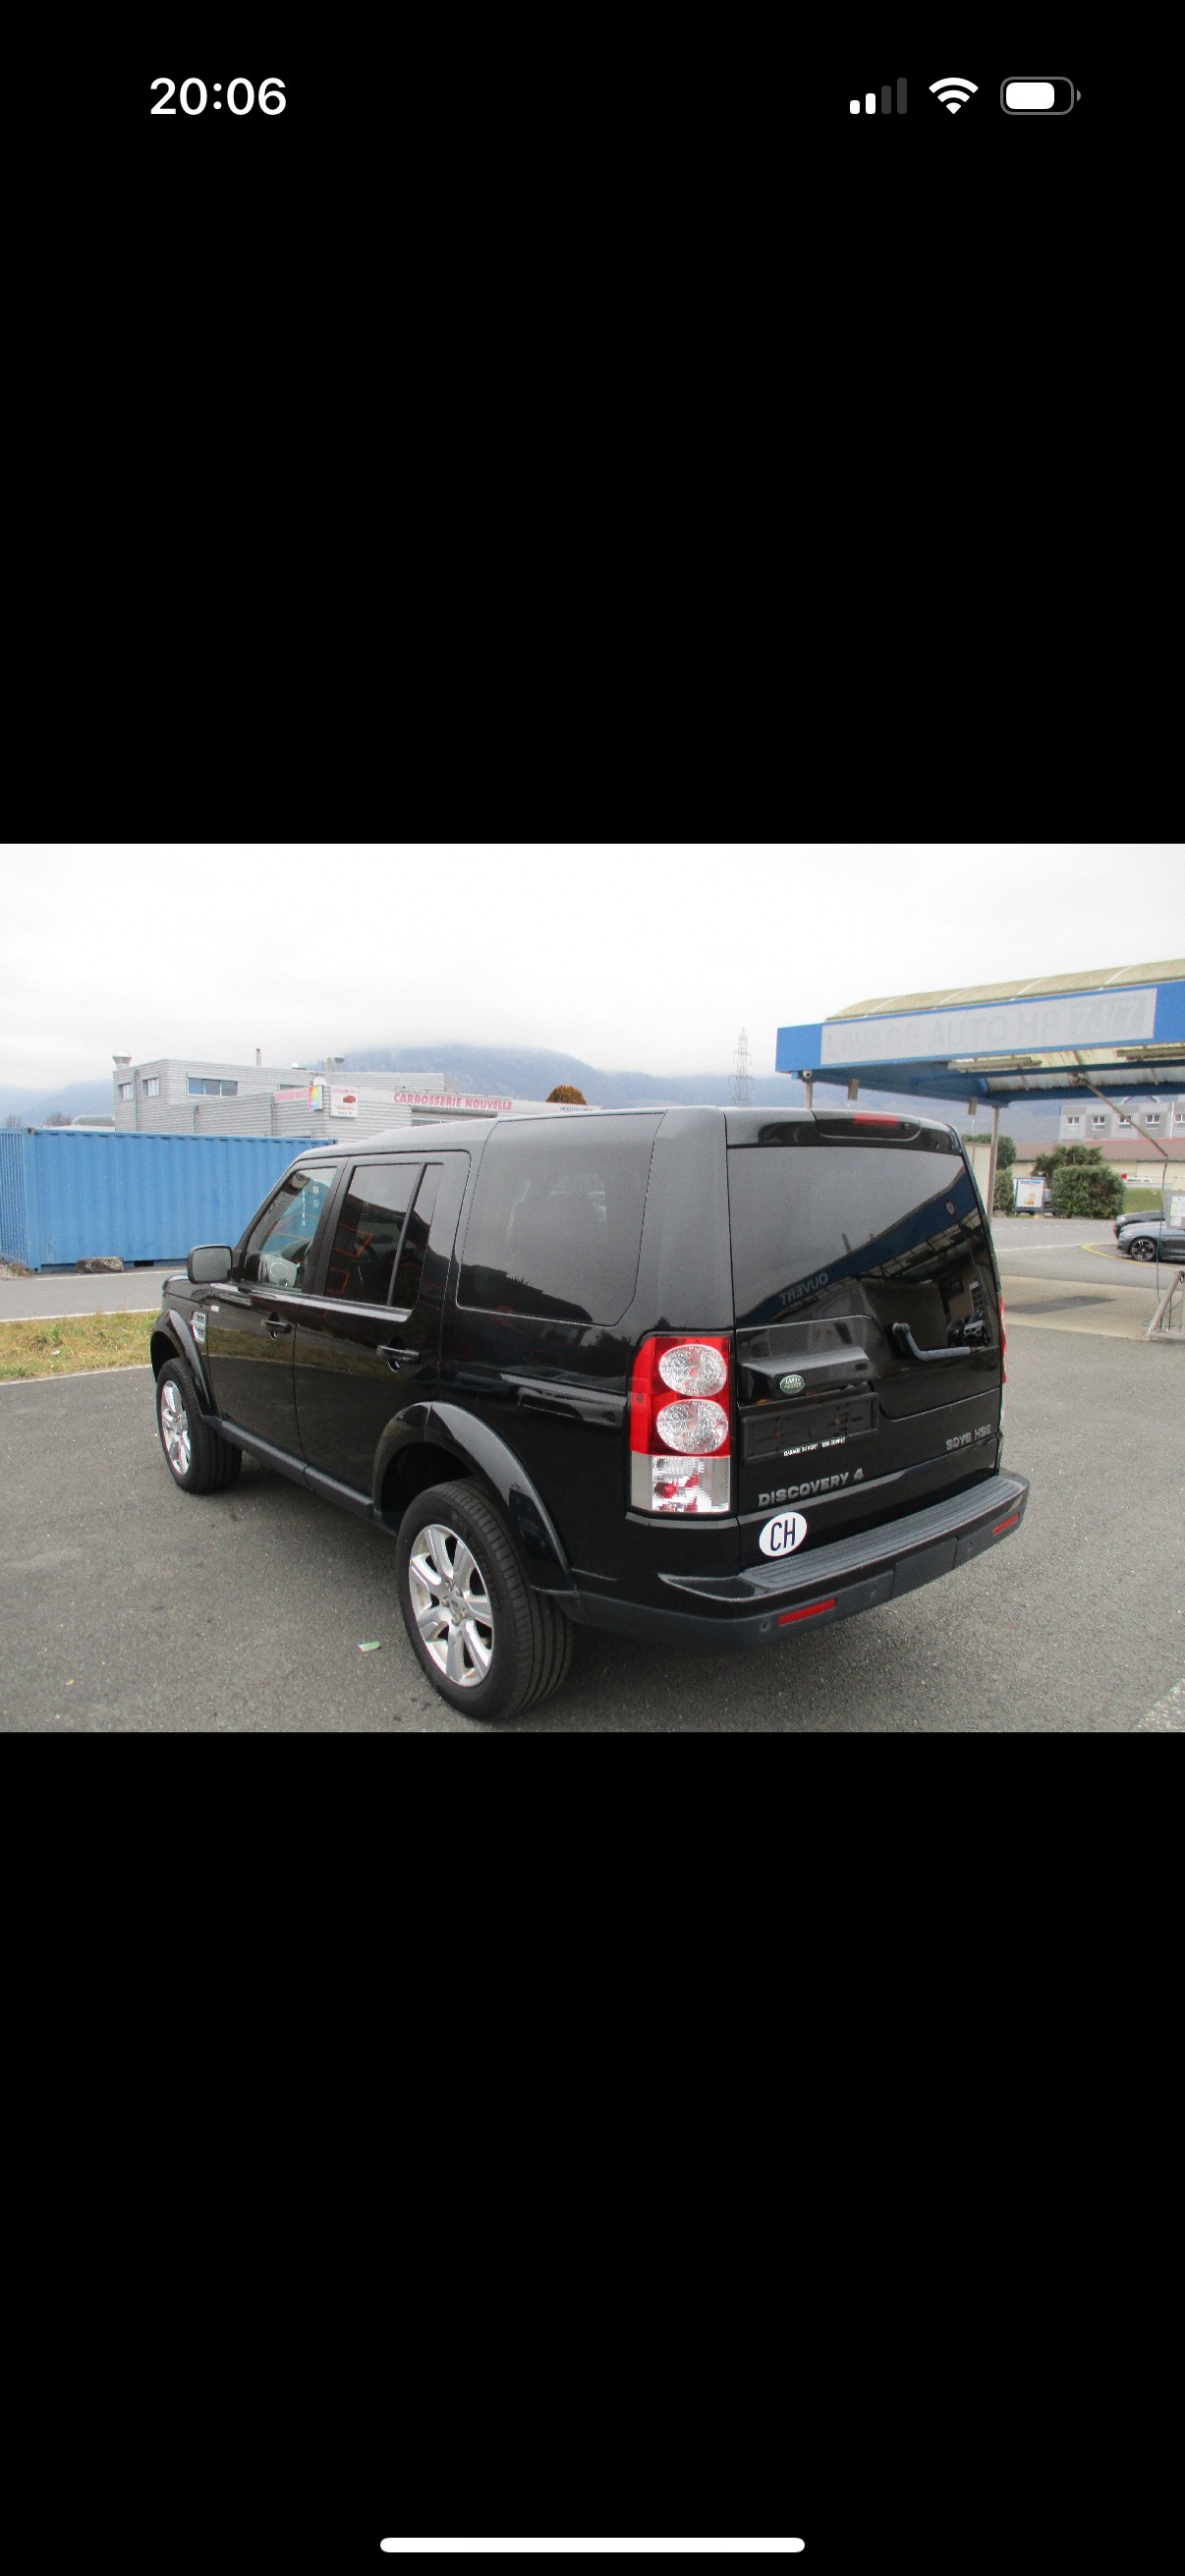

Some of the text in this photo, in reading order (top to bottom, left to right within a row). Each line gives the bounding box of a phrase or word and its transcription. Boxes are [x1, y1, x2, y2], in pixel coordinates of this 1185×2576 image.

[928, 1014, 1009, 1051] AUTO
[393, 1092, 513, 1111] CARROSSERIE NOUVELLE
[758, 1468, 865, 1508] DISCOVERY 4
[770, 1518, 796, 1551] CH
